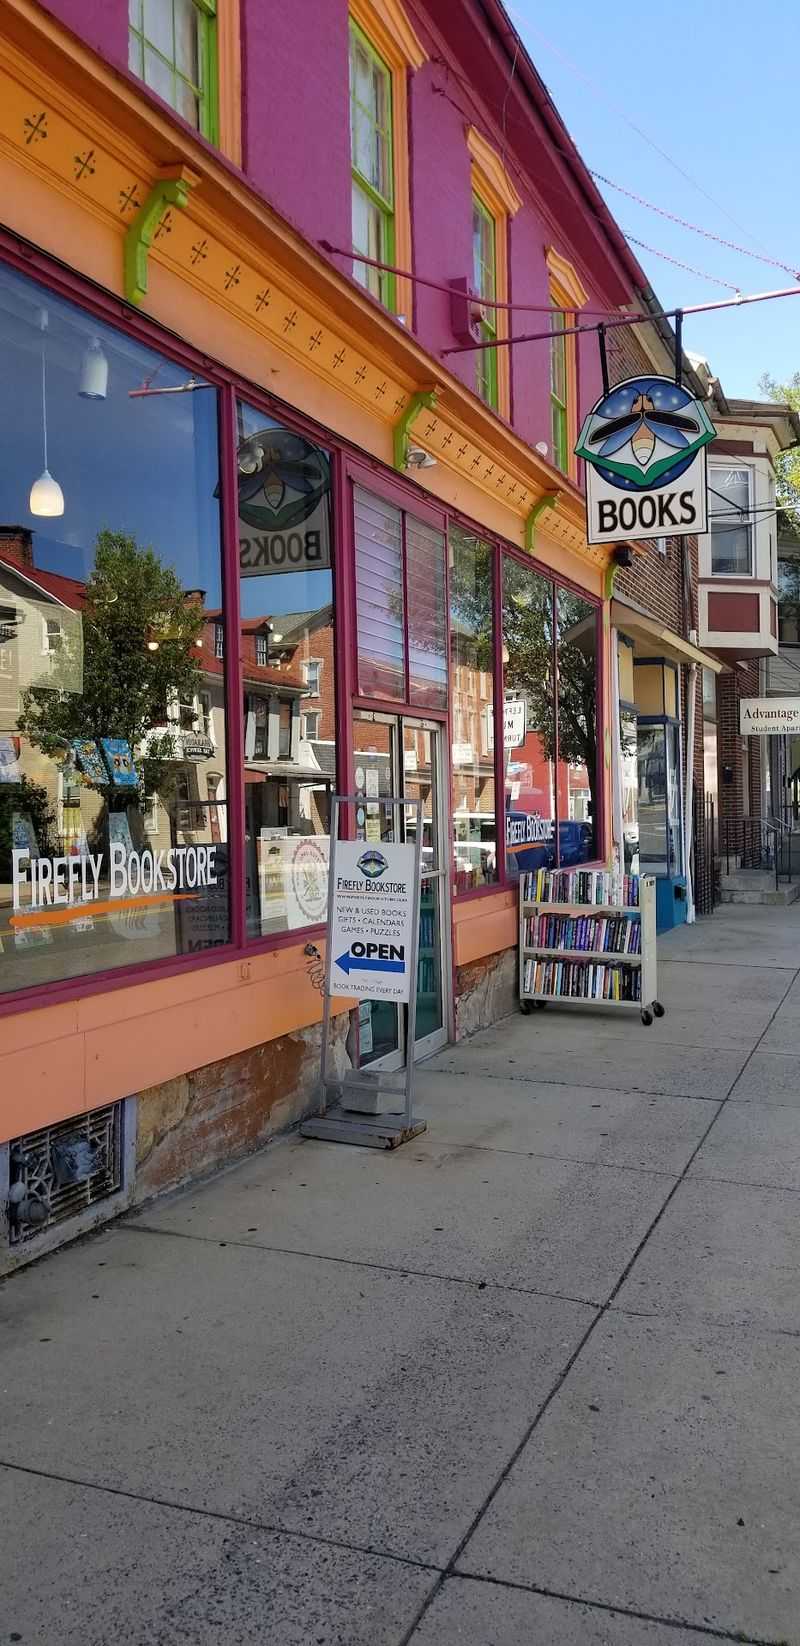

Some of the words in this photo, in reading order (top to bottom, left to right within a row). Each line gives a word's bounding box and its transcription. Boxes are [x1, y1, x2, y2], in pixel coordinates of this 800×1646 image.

[598, 490, 696, 533] BOOKS
[743, 707, 799, 721] Advantage
[12, 847, 104, 909] FIREFLY
[109, 842, 218, 897] BOOKSTORE
[337, 877, 364, 891] FIREFLY
[365, 879, 406, 894] BOOKSTORE
[337, 905, 354, 913] NEW
[381, 909, 407, 918] BOOKS
[338, 915, 357, 923] GIFTS
[362, 917, 405, 927] CALENDARS
[341, 926, 365, 934] GAMES
[370, 927, 401, 937] PUZZLES
[351, 941, 405, 961] OPEN
